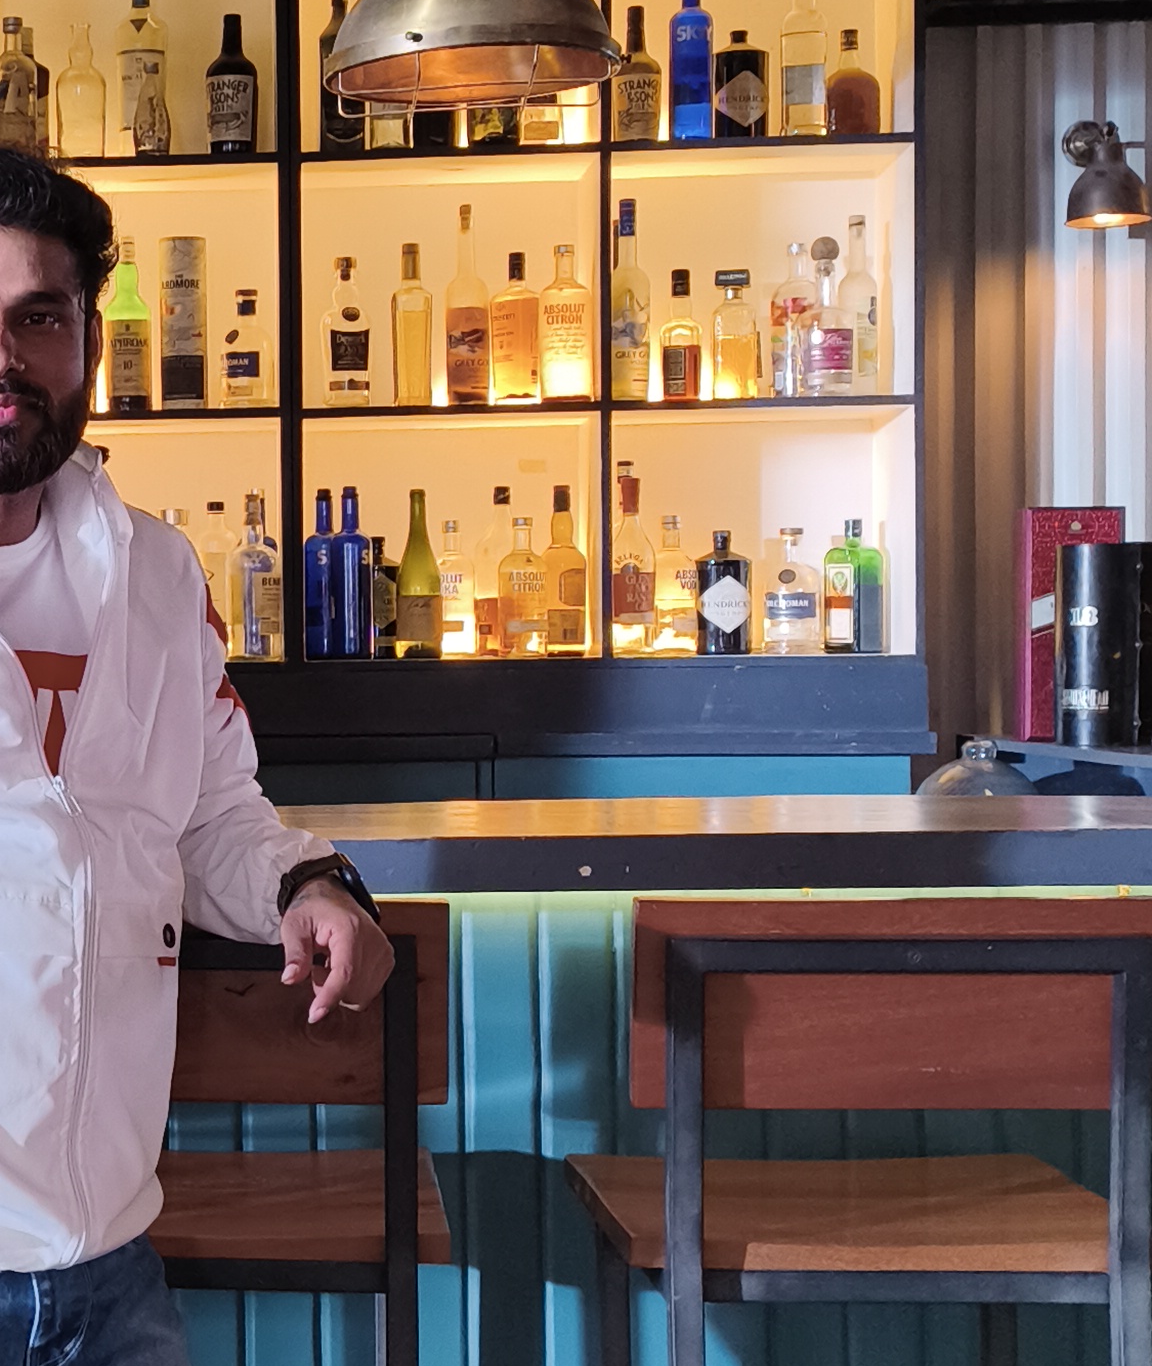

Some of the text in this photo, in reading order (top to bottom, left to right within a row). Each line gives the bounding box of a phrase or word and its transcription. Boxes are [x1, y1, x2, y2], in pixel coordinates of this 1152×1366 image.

[543, 303, 585, 316] ABSOLUT
[546, 313, 583, 325] CITRON
[122, 359, 133, 371] 10
